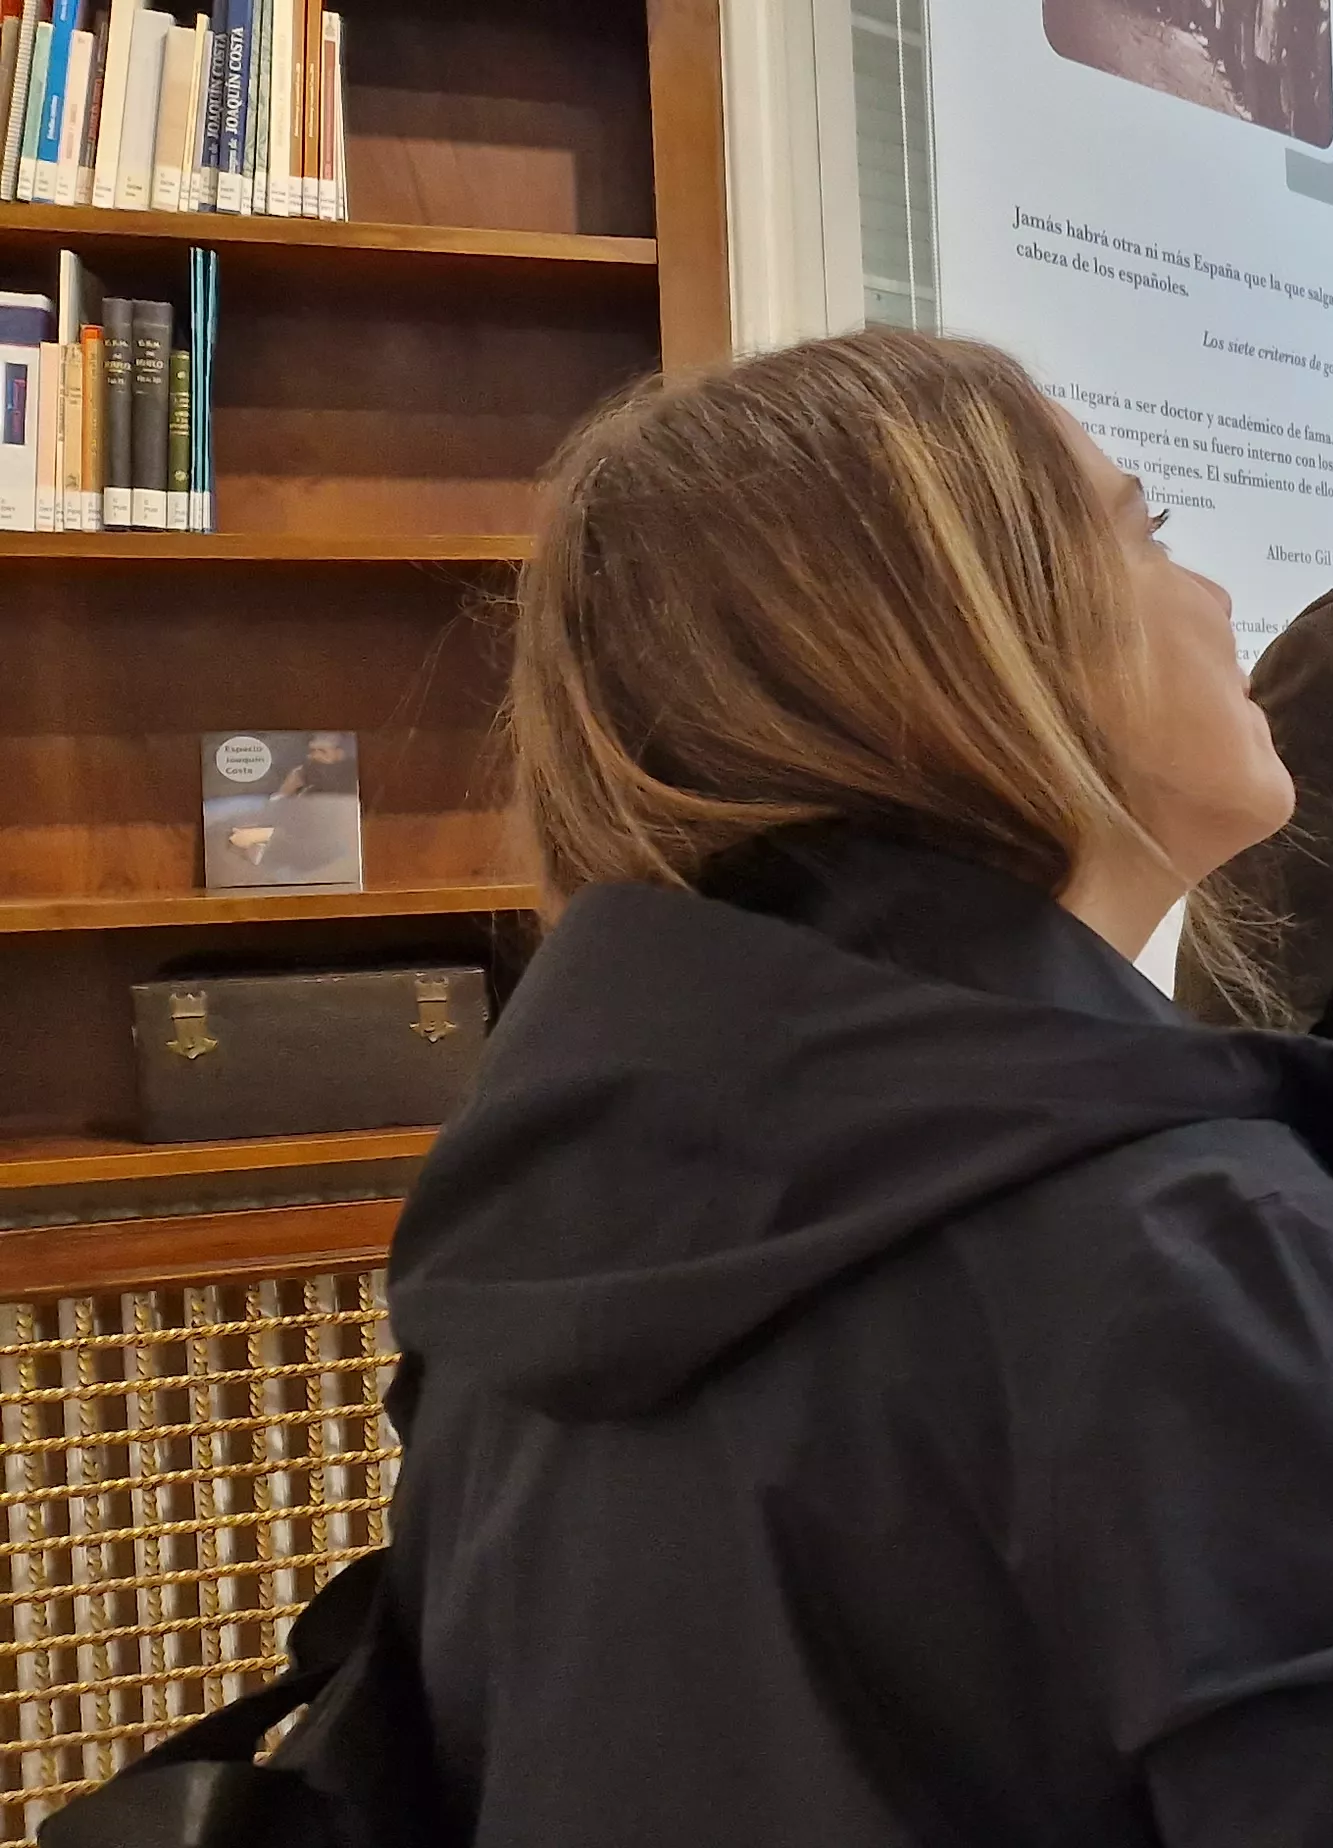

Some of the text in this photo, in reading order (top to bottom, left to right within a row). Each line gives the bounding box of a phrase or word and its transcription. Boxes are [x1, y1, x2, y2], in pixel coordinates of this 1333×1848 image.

[211, 34, 228, 76] COSTA
[229, 27, 244, 71] COSTA
[225, 74, 242, 134] JOAQUÍN
[1012, 205, 1062, 234] Jamás
[1066, 219, 1109, 247] habrá
[1113, 238, 1142, 256] otra
[1145, 243, 1158, 260] ni
[1162, 250, 1190, 268] más
[1194, 253, 1240, 281] España
[1244, 272, 1266, 289] que
[1270, 274, 1282, 291] la
[1284, 283, 1305, 299] que
[1016, 242, 1189, 296] cabeza de los españoles.
[1203, 330, 1224, 350] Los
[1228, 339, 1255, 356] siete
[1258, 346, 1306, 367] criterios
[1309, 354, 1321, 370] de
[1070, 383, 1333, 445] llegará a ser doctor y académico de fama.
[1267, 544, 1311, 564] Alberto
[1315, 549, 1331, 566] Gil
[225, 767, 253, 775] Costa
